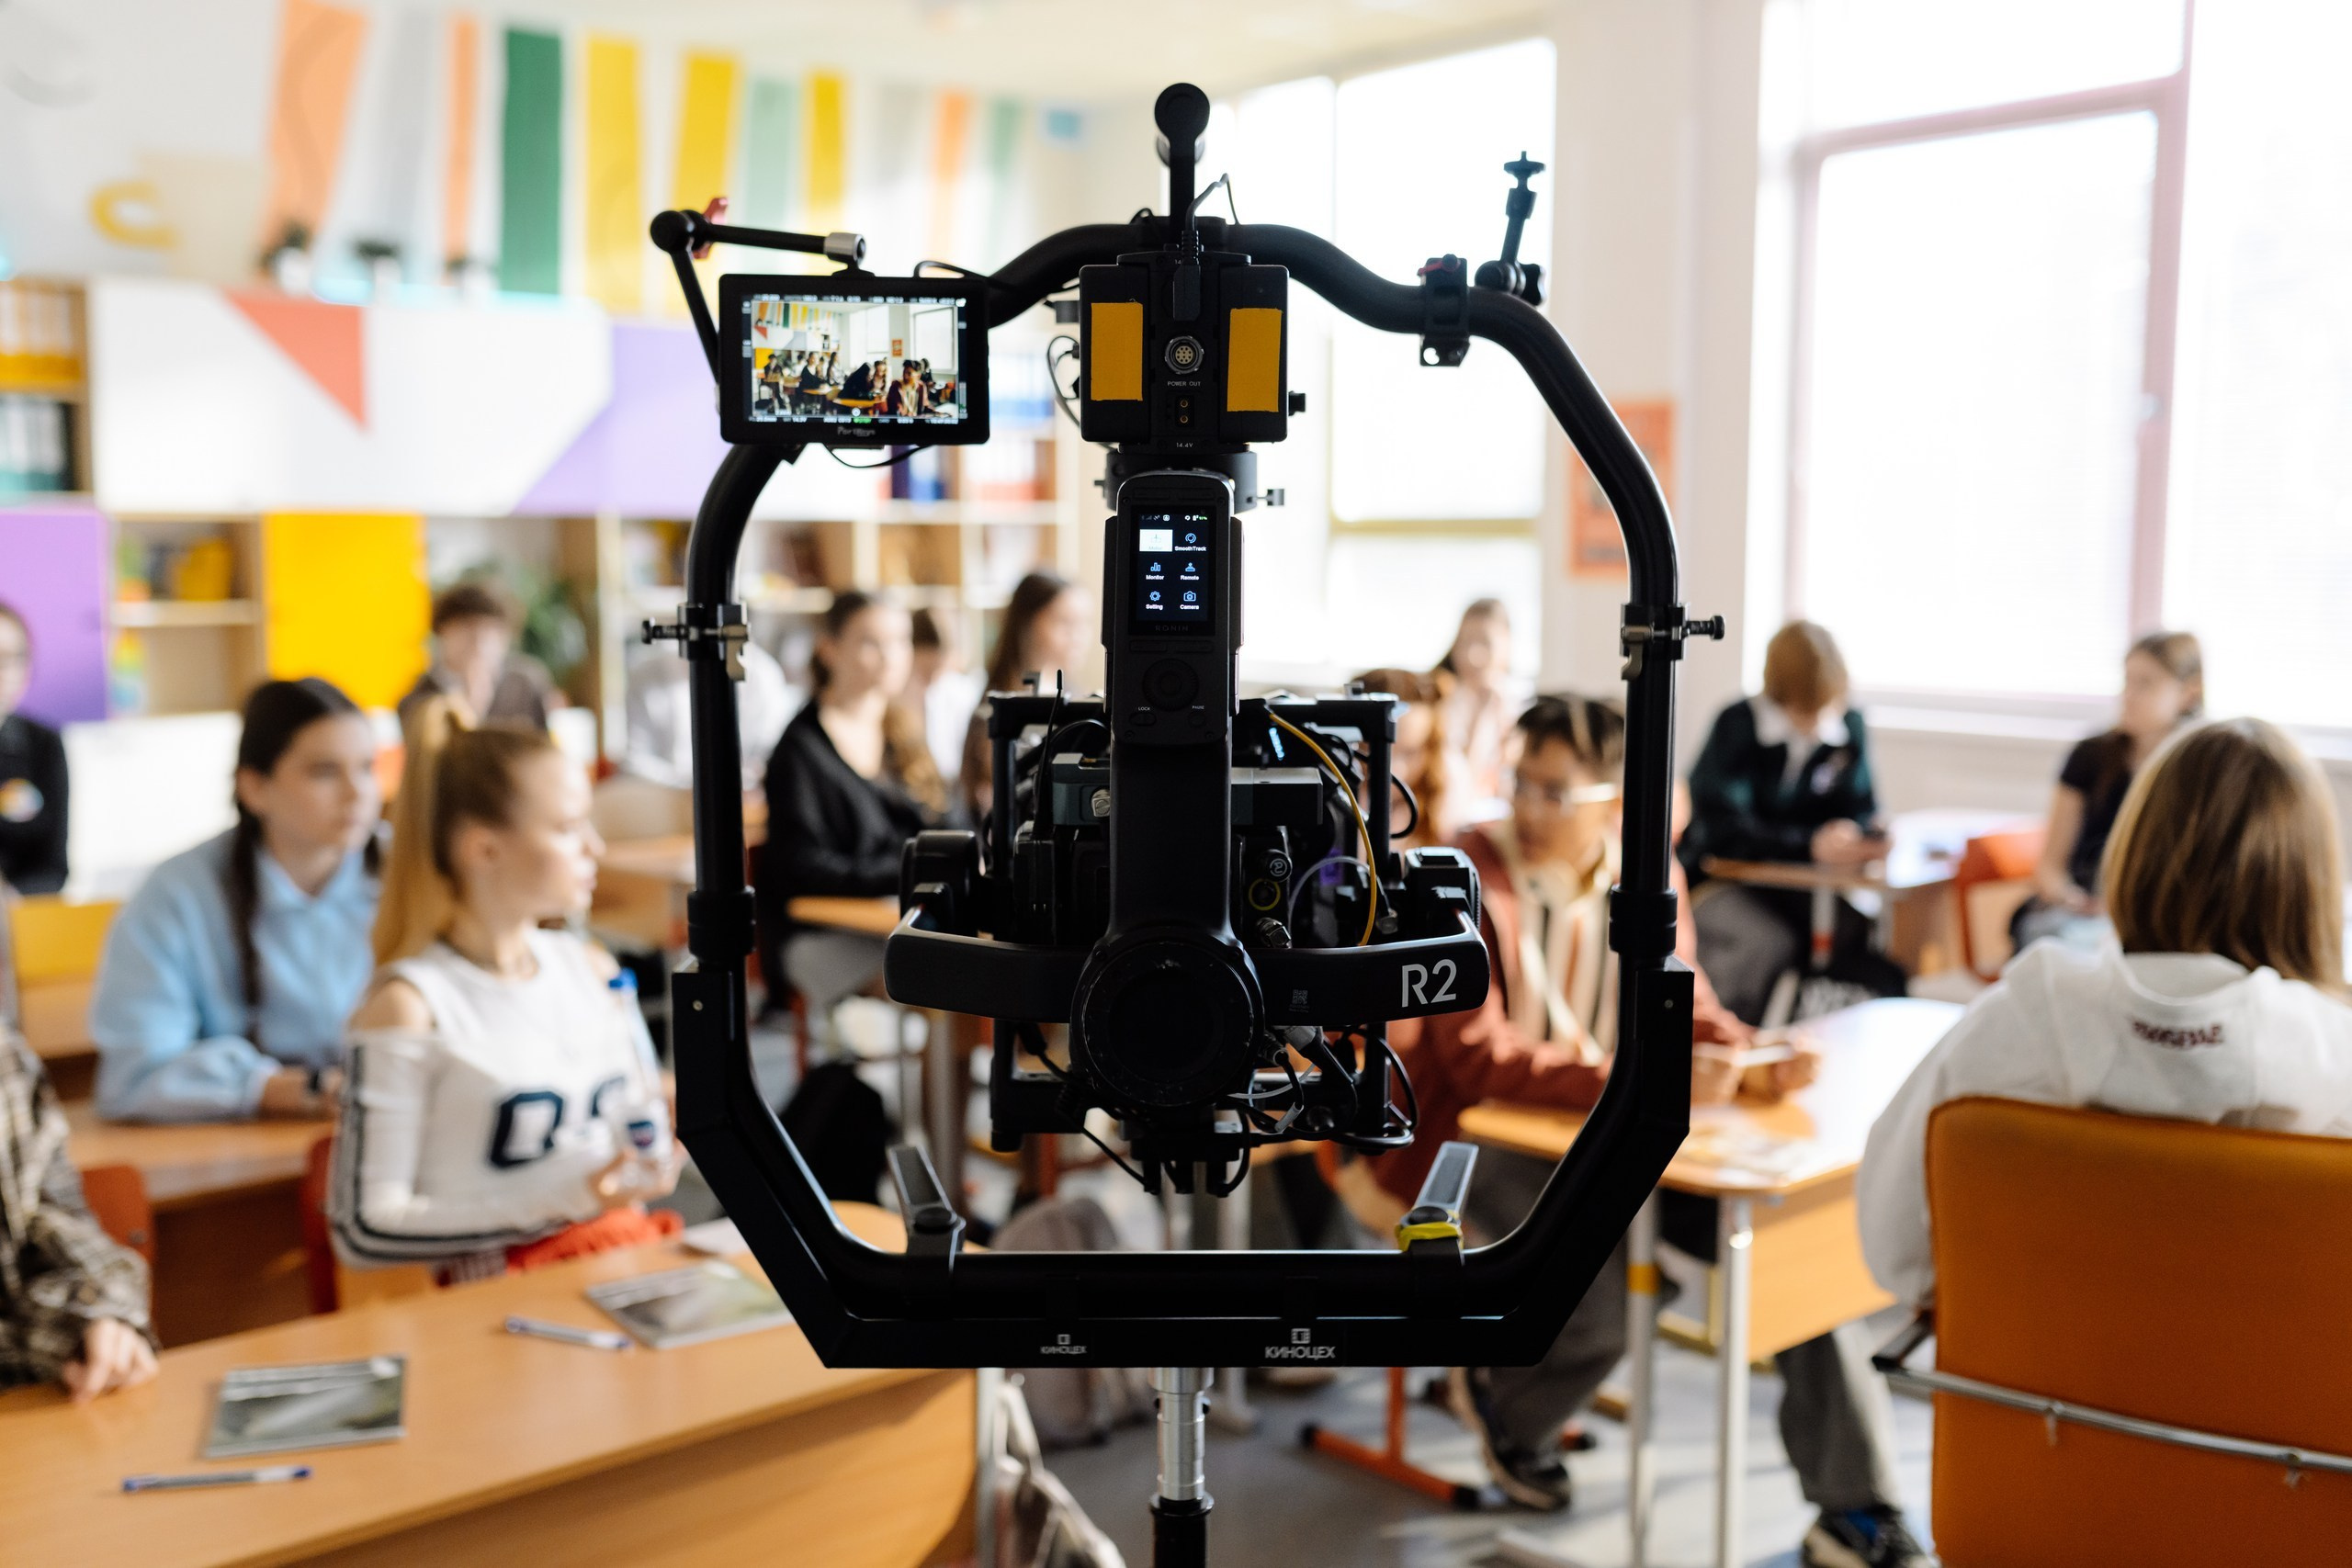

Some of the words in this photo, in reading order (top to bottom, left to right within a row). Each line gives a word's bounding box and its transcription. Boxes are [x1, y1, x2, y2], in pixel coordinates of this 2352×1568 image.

[1401, 958, 1457, 1008] R2
[1040, 1346, 1088, 1355] КИНОЦЕХ
[1264, 1346, 1336, 1360] КИНОЦЕХ
